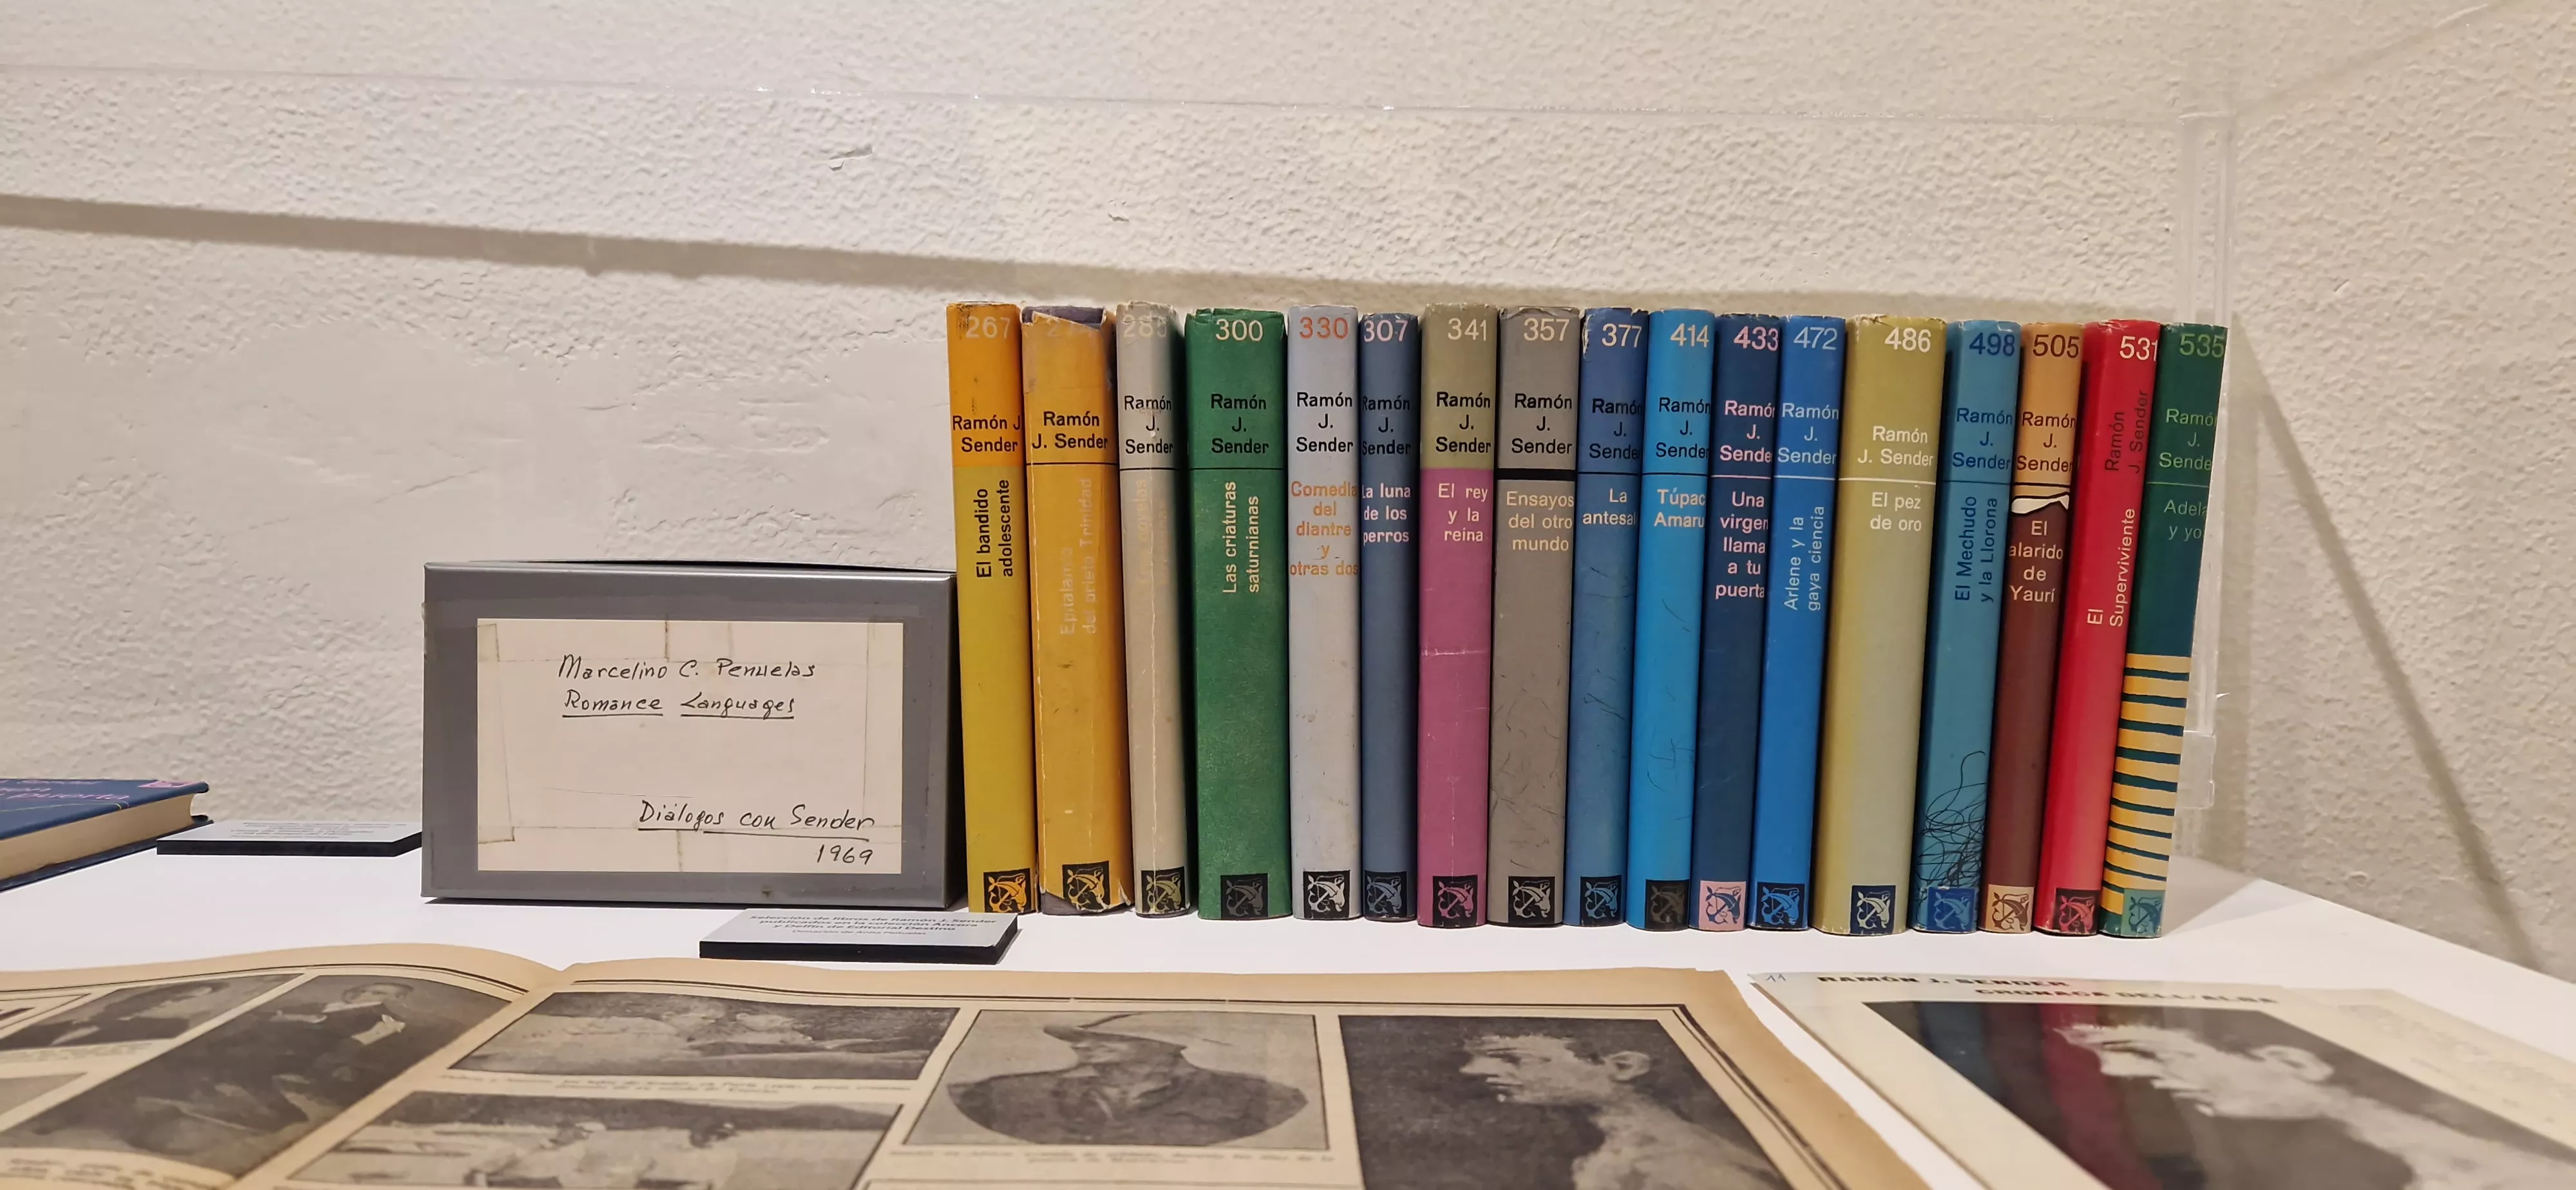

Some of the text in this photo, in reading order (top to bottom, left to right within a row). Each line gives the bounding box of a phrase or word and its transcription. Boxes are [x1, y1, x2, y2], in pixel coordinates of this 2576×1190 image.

[966, 316, 1010, 339] 267
[1216, 319, 1264, 341] 300
[1299, 317, 1349, 340] 330
[1363, 320, 1409, 343] 307
[1448, 317, 1488, 341] 341
[1523, 318, 1570, 341] 357
[1602, 323, 1643, 348] 377
[1670, 323, 1710, 348] 414
[1734, 326, 1779, 351] 433
[1793, 326, 1837, 350] 472
[1884, 326, 1931, 352] 486
[1969, 332, 2016, 357] 498
[2032, 334, 2079, 358] 505
[2179, 333, 2225, 359] 535
[2119, 335, 2158, 361] 531
[1124, 395, 1171, 410] Ramón
[1211, 393, 1267, 410] Ramón
[1296, 392, 1352, 408] Ramón
[1362, 395, 1410, 411] Ramón
[1436, 392, 1491, 408] Ramón
[1515, 393, 1572, 409] Ramón
[1659, 397, 1710, 414] Ramón
[1043, 411, 1100, 427] Ramón
[1782, 402, 1839, 419] Ramón
[1956, 408, 2012, 425] Ramón
[952, 415, 1008, 431] Ramón
[1146, 415, 1159, 431] J.
[1232, 417, 1247, 432] J.
[1318, 413, 1334, 429] J.
[1378, 417, 1393, 433] J.
[1459, 414, 1474, 430] J.
[1536, 416, 1550, 431] J.
[1680, 420, 1692, 435] J.
[2022, 411, 2076, 428] Ramón
[1613, 421, 1627, 437] J.
[1747, 424, 1760, 439] J.
[1804, 426, 1818, 442] J.
[1872, 426, 1928, 444] Ramón
[2128, 390, 2148, 474] J. Sender
[961, 437, 1018, 453] Sender
[1032, 433, 1108, 449] J. Sender
[1125, 438, 1173, 454] Sender
[1211, 438, 1269, 454] Sender
[1296, 437, 1354, 453] Sender
[1435, 437, 1491, 453] Sender
[1511, 438, 1573, 454] Sender
[1980, 431, 1993, 446] J.
[2043, 433, 2057, 448] J.
[2105, 411, 2125, 471] Ramón
[2187, 432, 2200, 447] J.
[1362, 439, 1411, 456] Sender
[1719, 444, 1772, 463] Sende
[1777, 447, 1837, 464] Sender
[1857, 448, 1933, 466] J. Sender
[1952, 451, 2011, 469] Sender
[1291, 481, 1358, 497] Comedia
[1362, 483, 1410, 498] La luna
[1438, 483, 1488, 502] El rey
[1609, 487, 1627, 503] La
[1507, 491, 1575, 511] Ensayos
[1657, 487, 1706, 509] Túpac
[1732, 491, 1765, 507] Una
[1871, 492, 1921, 511] El pez
[1313, 501, 1336, 516] del
[1364, 505, 1407, 520] de los
[1448, 507, 1479, 524] y la
[1508, 514, 1573, 529] del otro
[1582, 511, 1636, 525] antesal
[1653, 511, 1705, 527] Amaru
[1720, 513, 1768, 534] virgen
[1870, 515, 1921, 531] de oro
[974, 489, 992, 578] El bandido
[996, 480, 1013, 577] adolescente
[1222, 481, 1236, 592] Las criaturas
[1296, 521, 1351, 536] diantre
[1444, 527, 1483, 542] reina
[2031, 520, 2047, 536] El
[2168, 525, 2202, 542] y yo
[1245, 496, 1259, 593] saturnianas
[1363, 531, 1409, 547] perros
[1512, 536, 1569, 551] mundo
[1723, 536, 1765, 554] llama
[1321, 545, 1330, 559] y
[1955, 496, 1976, 600] El Mechudo
[1978, 498, 1997, 603] y la Llorona
[2009, 542, 2063, 560] alarido
[1727, 560, 1761, 574] a tu
[1784, 517, 1805, 610] Arlene y la
[1808, 506, 1824, 611] gaya ciencia
[1290, 560, 1358, 575] otras dos
[2023, 566, 2046, 581] de
[2109, 508, 2136, 627] Superviviente
[1715, 583, 1765, 600] puerta
[2010, 585, 2056, 603] Yaurí
[2087, 609, 2104, 625] El
[558, 654, 816, 681] Marcelino C. Penuelas
[564, 689, 795, 720] Romance Languages
[739, 812, 777, 829] con
[791, 804, 876, 832] Sender
[815, 844, 873, 866] 1969
[1817, 975, 1920, 983] RAMÓN
[1954, 978, 2070, 987] SENDER
[1975, 989, 2110, 997] CRONACA
